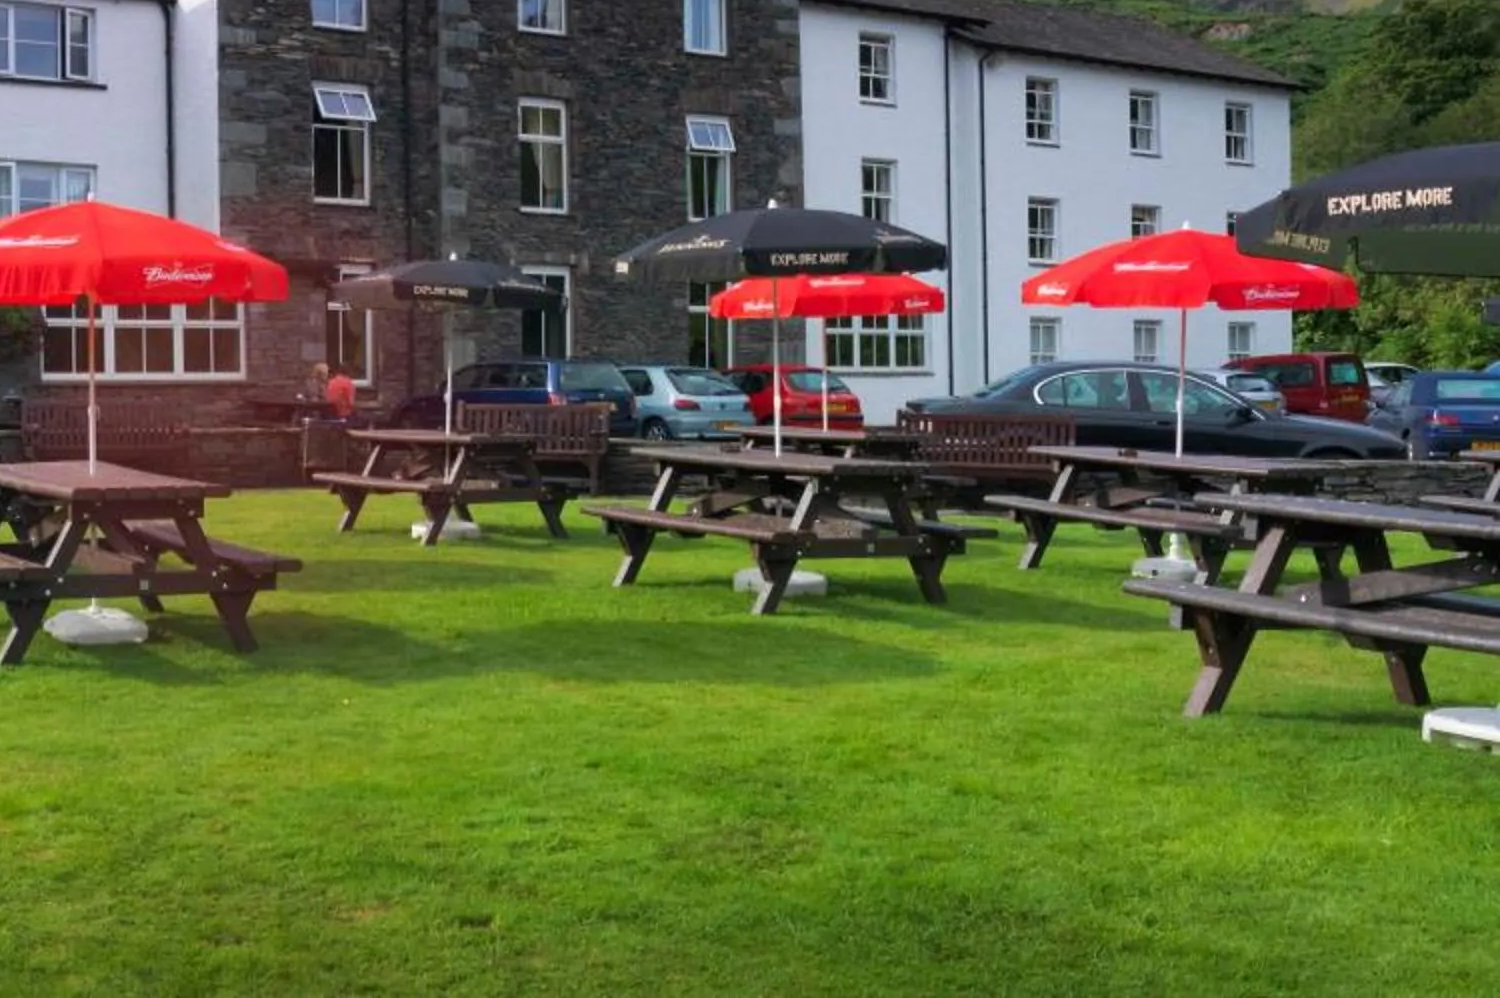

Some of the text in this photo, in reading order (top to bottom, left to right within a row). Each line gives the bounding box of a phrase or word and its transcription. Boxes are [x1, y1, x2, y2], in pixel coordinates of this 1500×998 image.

[1327, 186, 1454, 216] EXPLORE MORE
[770, 252, 850, 267] EXPLORE MORE
